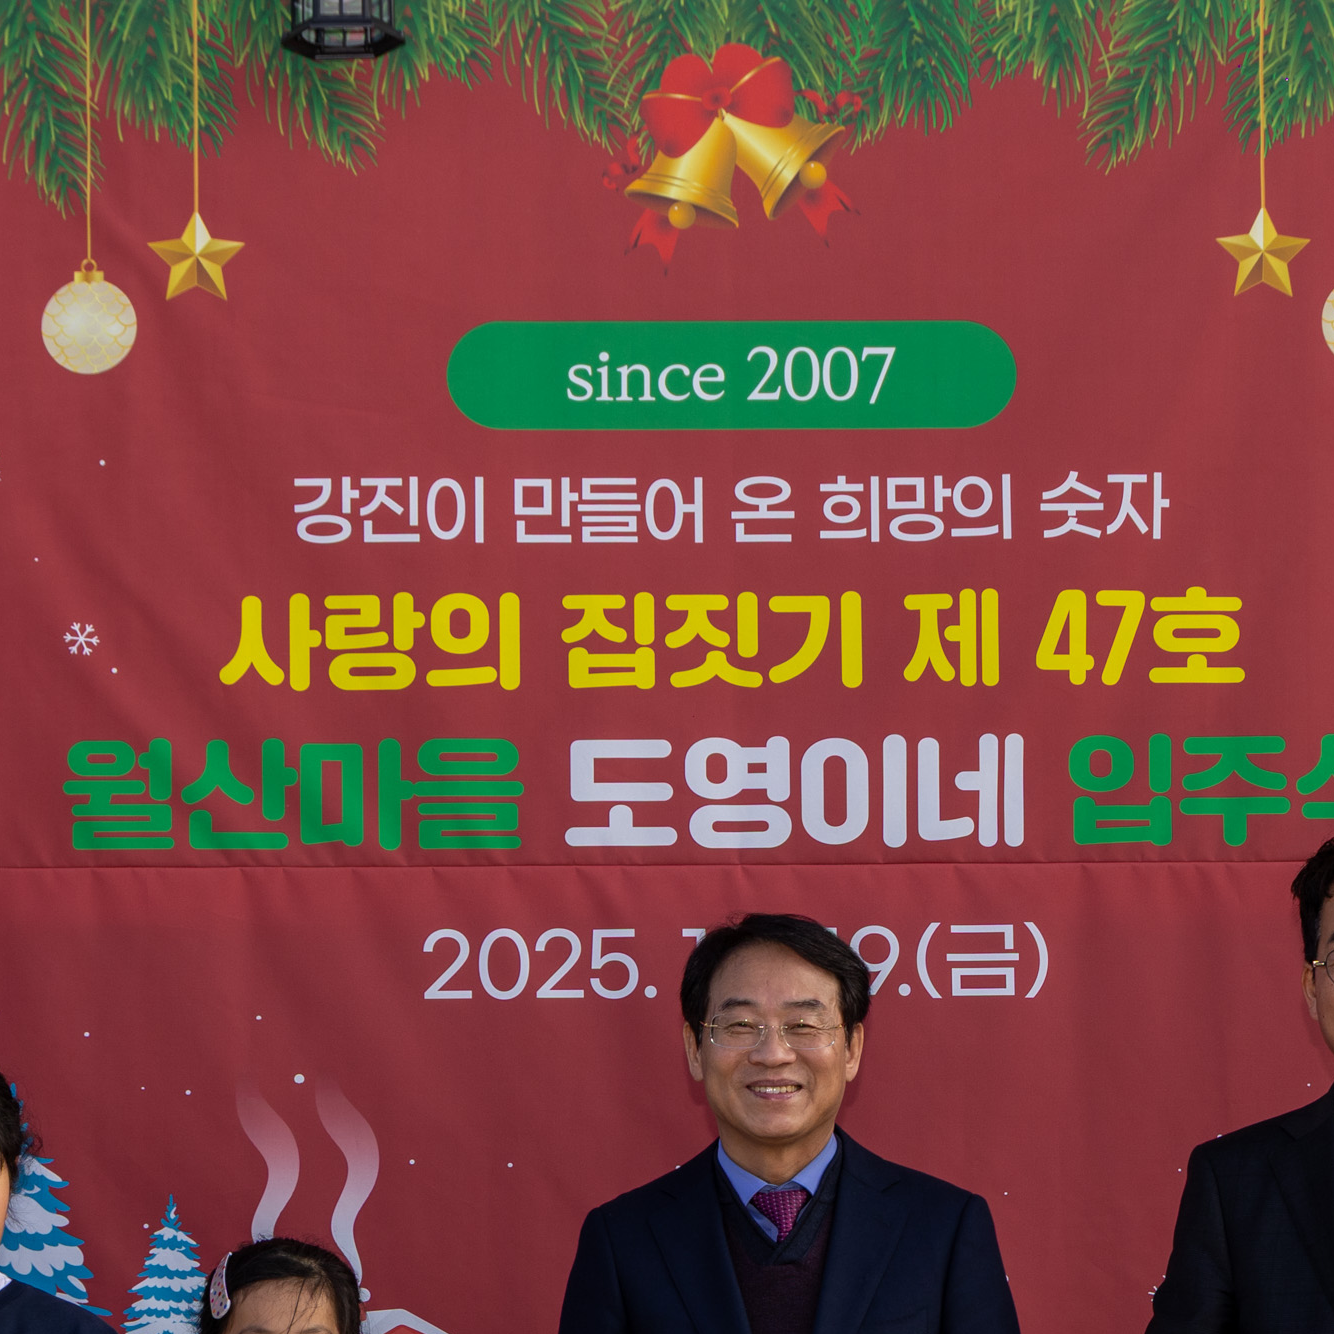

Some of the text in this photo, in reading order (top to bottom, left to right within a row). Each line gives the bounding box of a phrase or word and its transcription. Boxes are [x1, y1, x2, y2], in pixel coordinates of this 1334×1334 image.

[567, 345, 896, 405] since 2007
[294, 470, 1170, 544] 강진이 만들어 온 희망의 숫자
[219, 586, 1246, 692] 사랑의 집짓기 제 47호
[62, 737, 525, 851] 월산마을
[564, 733, 1025, 849] 도영이네
[423, 921, 1049, 1000] 2025. 9.(금)
